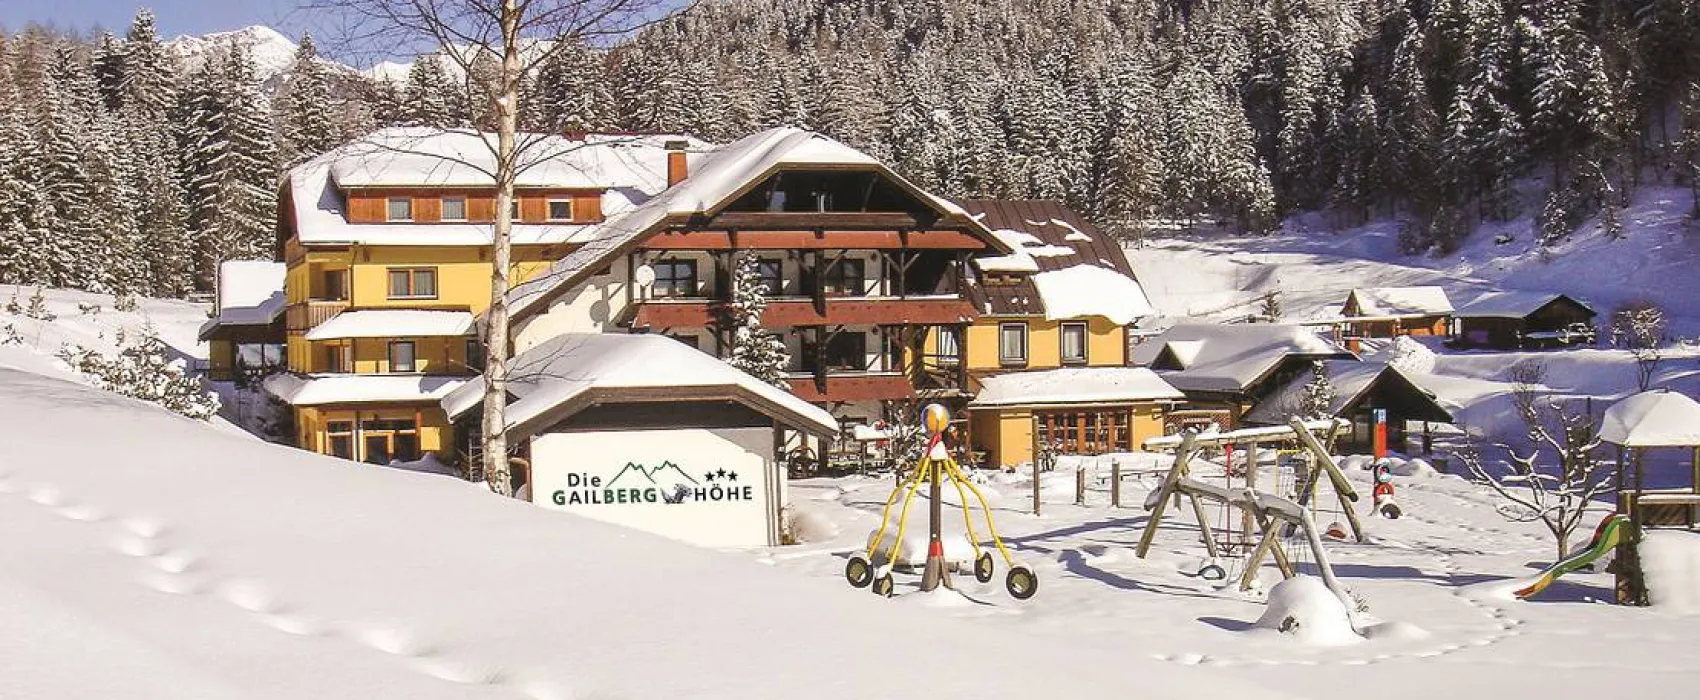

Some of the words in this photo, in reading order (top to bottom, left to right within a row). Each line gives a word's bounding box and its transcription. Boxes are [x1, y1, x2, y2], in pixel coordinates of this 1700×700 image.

[567, 472, 601, 487] Die
[552, 487, 657, 505] GAILBERG
[695, 483, 753, 501] HÖHE
